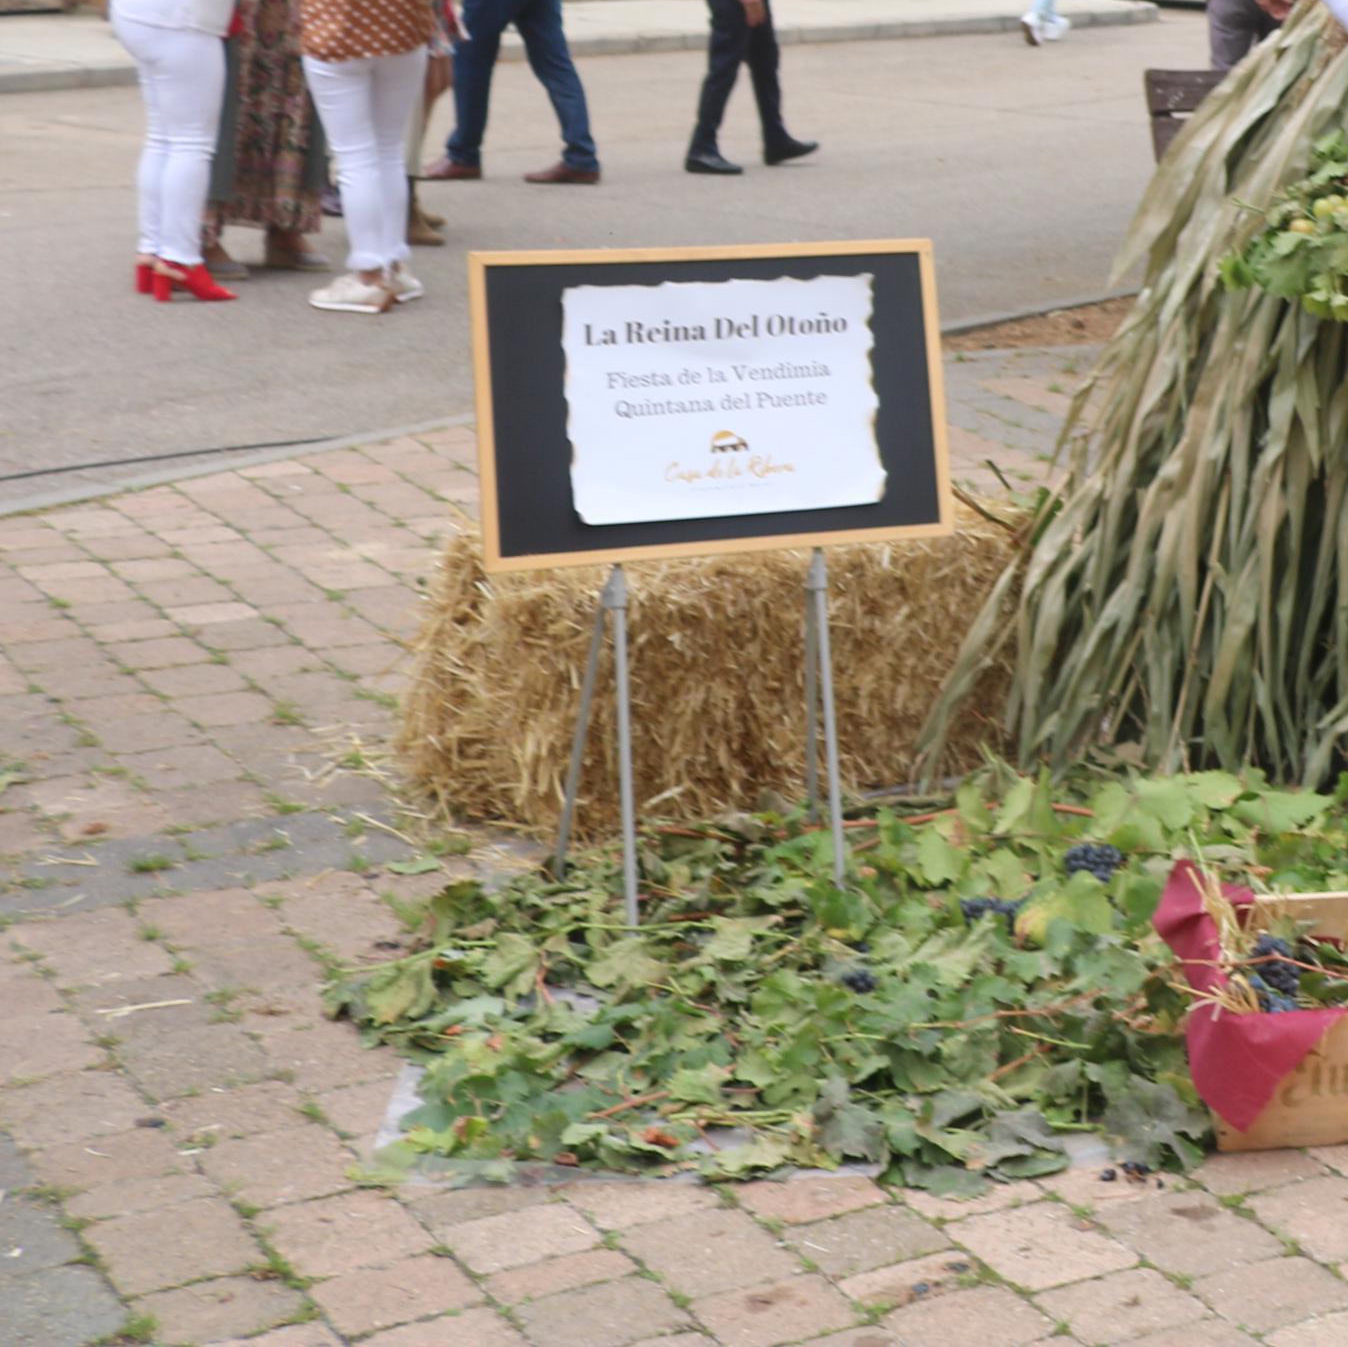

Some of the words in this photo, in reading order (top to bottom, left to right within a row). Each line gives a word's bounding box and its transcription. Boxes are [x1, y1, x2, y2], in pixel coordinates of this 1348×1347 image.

[584, 322, 617, 346] La
[625, 319, 707, 344] Reina
[714, 314, 759, 340] Del
[766, 312, 848, 338] Otoño
[606, 370, 673, 390] Fiesta
[678, 368, 703, 387] de
[707, 366, 728, 385] la
[732, 360, 832, 383] Vendimia
[614, 399, 715, 420] Quintana
[720, 393, 752, 412] del
[756, 390, 828, 410] Puente
